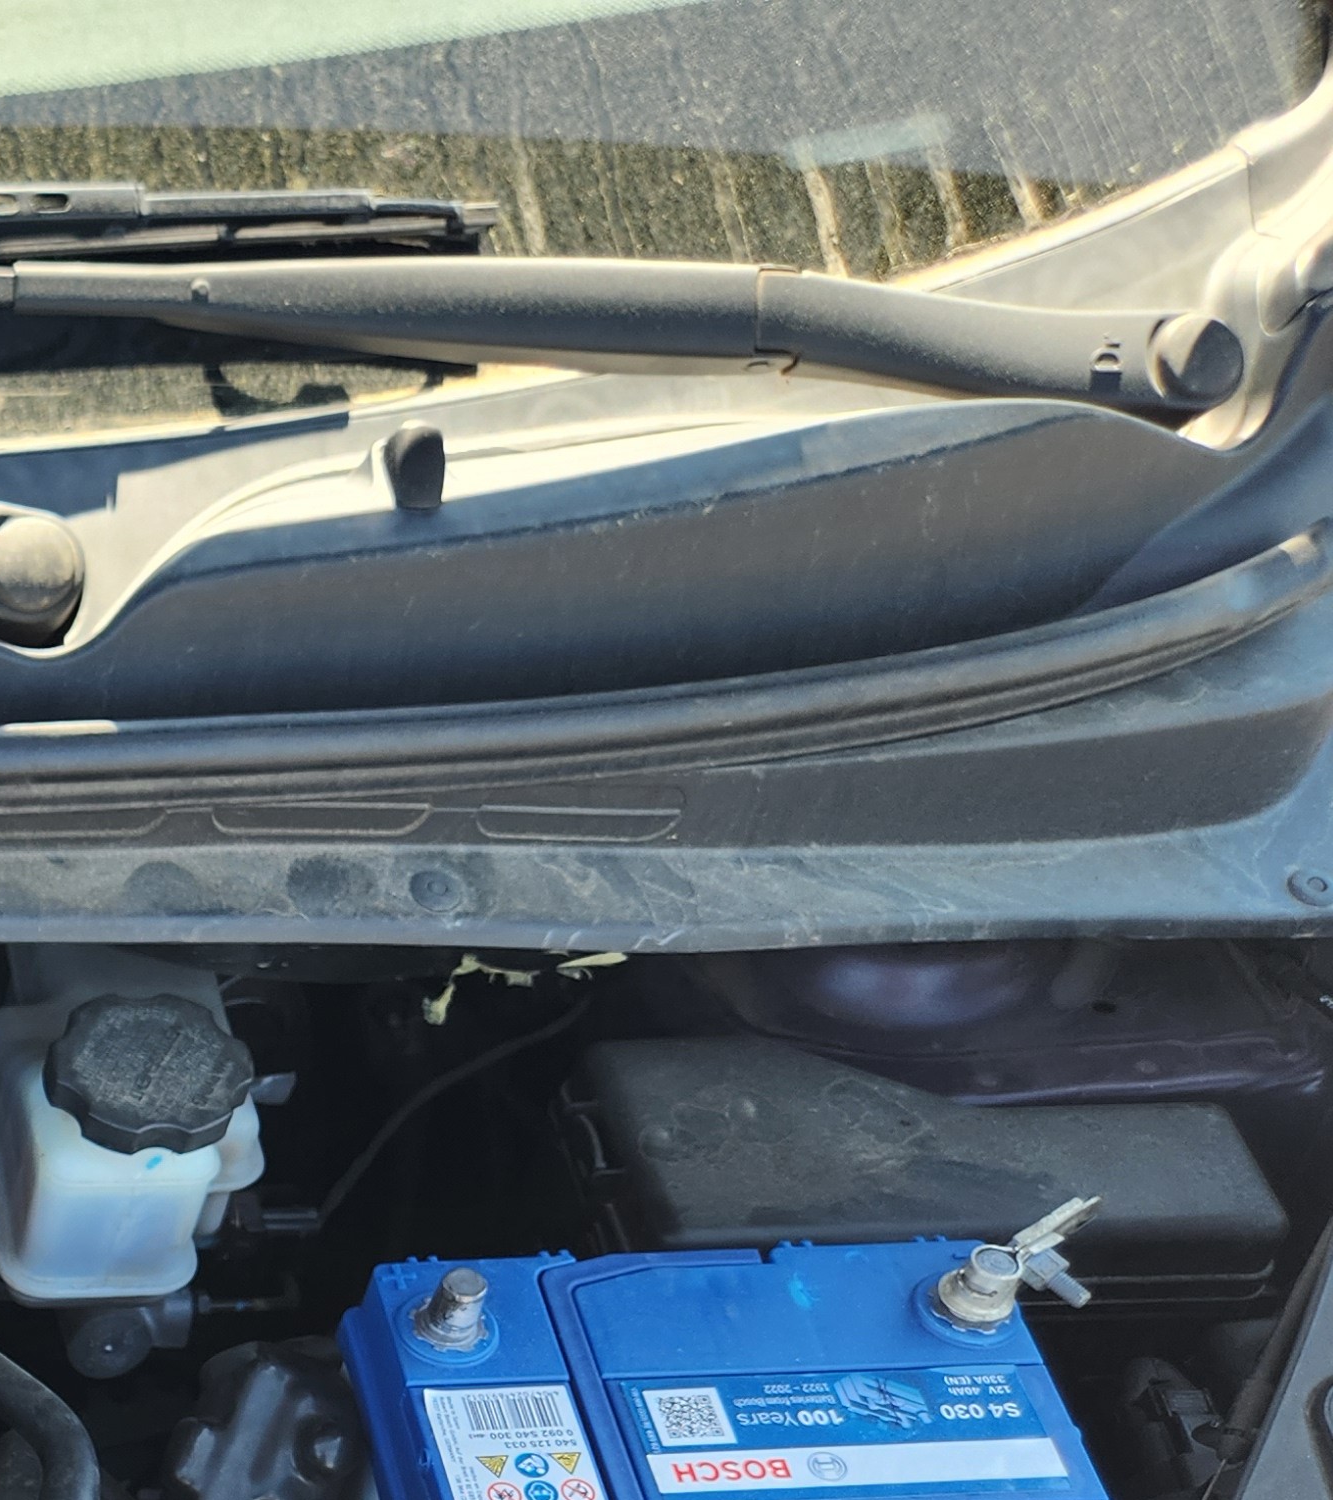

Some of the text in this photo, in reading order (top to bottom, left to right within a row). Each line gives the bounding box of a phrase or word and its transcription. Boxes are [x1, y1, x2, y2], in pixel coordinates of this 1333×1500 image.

[973, 1375, 1006, 1384] 330A
[763, 1384, 793, 1394] 2022
[801, 1383, 830, 1393] 1922
[947, 1384, 1011, 1396] 12V 40Ah
[939, 1402, 1022, 1420] S4 030
[736, 1409, 845, 1427] 100 Years
[671, 1458, 793, 1483] BOSCH
